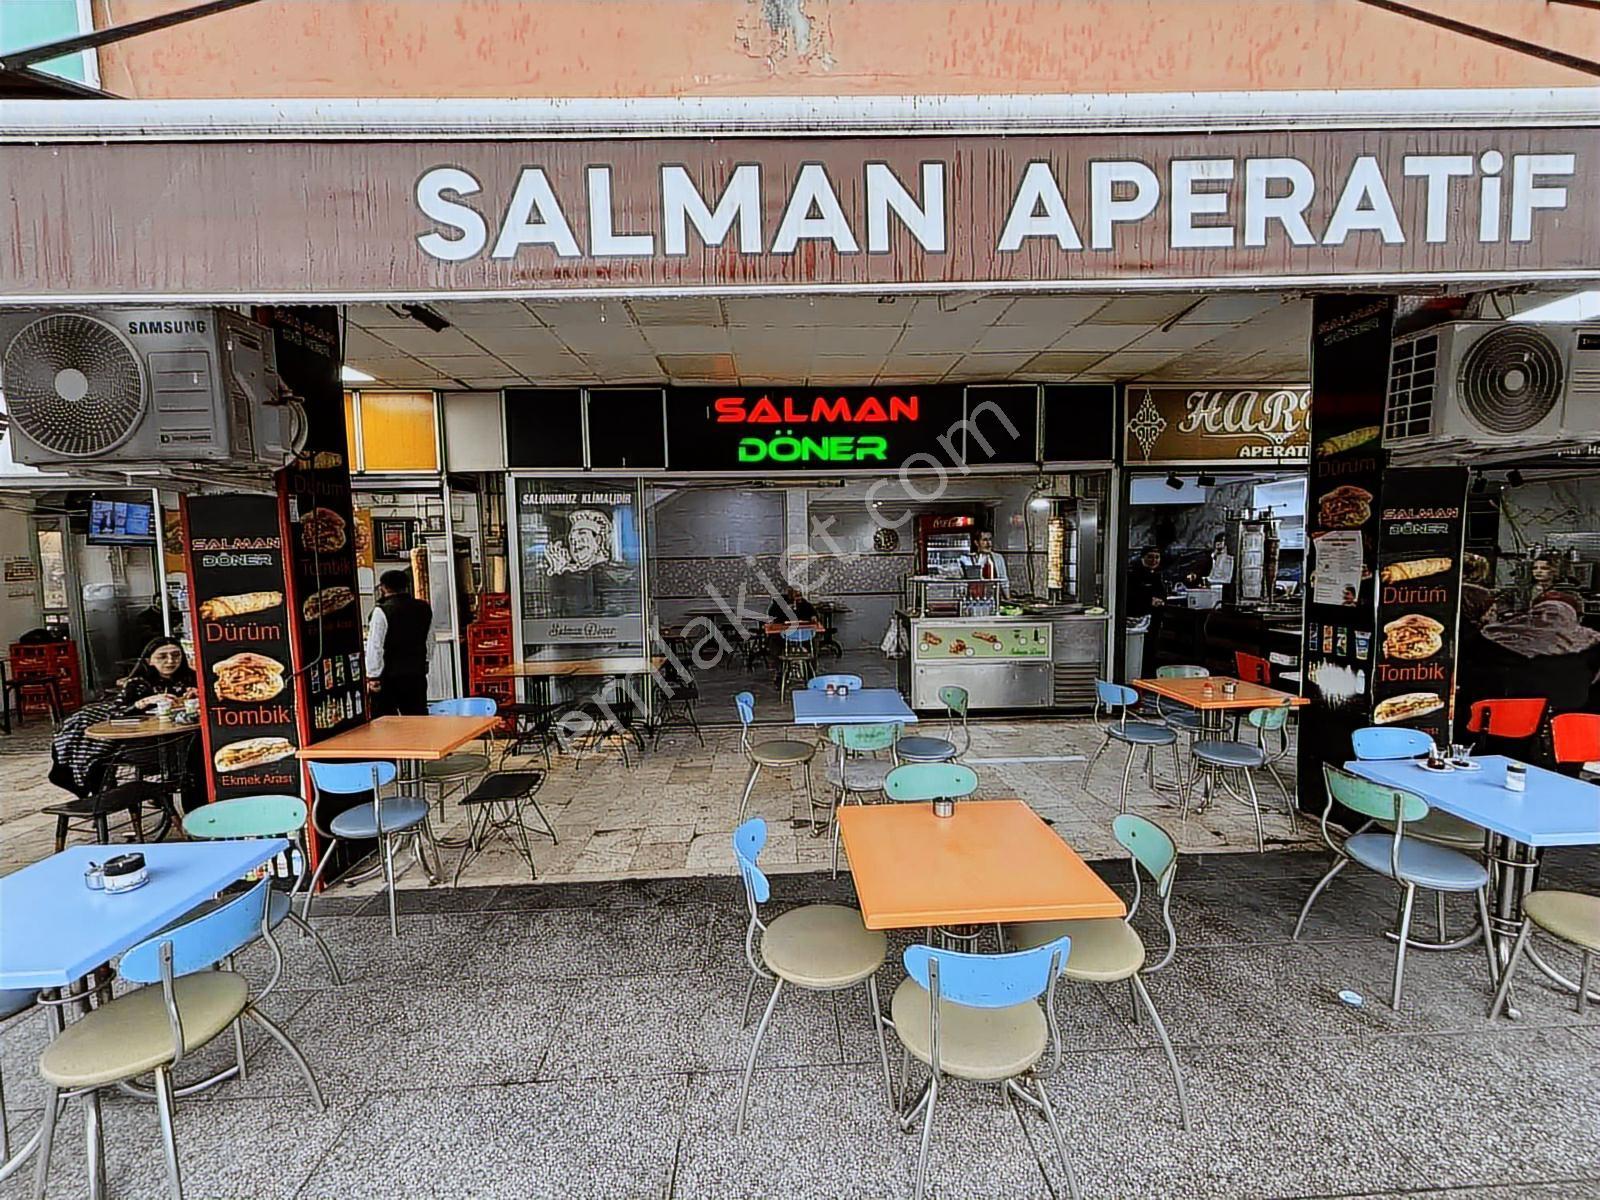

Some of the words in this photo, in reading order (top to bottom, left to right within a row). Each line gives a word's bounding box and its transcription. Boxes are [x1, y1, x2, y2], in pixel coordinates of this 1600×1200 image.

[416, 163, 946, 261] SALMAN
[129, 320, 207, 335] SAMSUNG
[714, 396, 919, 423] SALMAN
[738, 429, 888, 462] DÖNER
[1383, 507, 1459, 520] SALMAN
[1389, 522, 1448, 535] DÖNER
[192, 537, 281, 551] SALMAN
[203, 553, 273, 568] DÖNER
[1383, 584, 1447, 604] Dürüm
[206, 621, 281, 643] Dürüm
[1378, 662, 1445, 682] Tombik
[212, 704, 290, 726] Tombik
[221, 775, 260, 786] Ekmek
